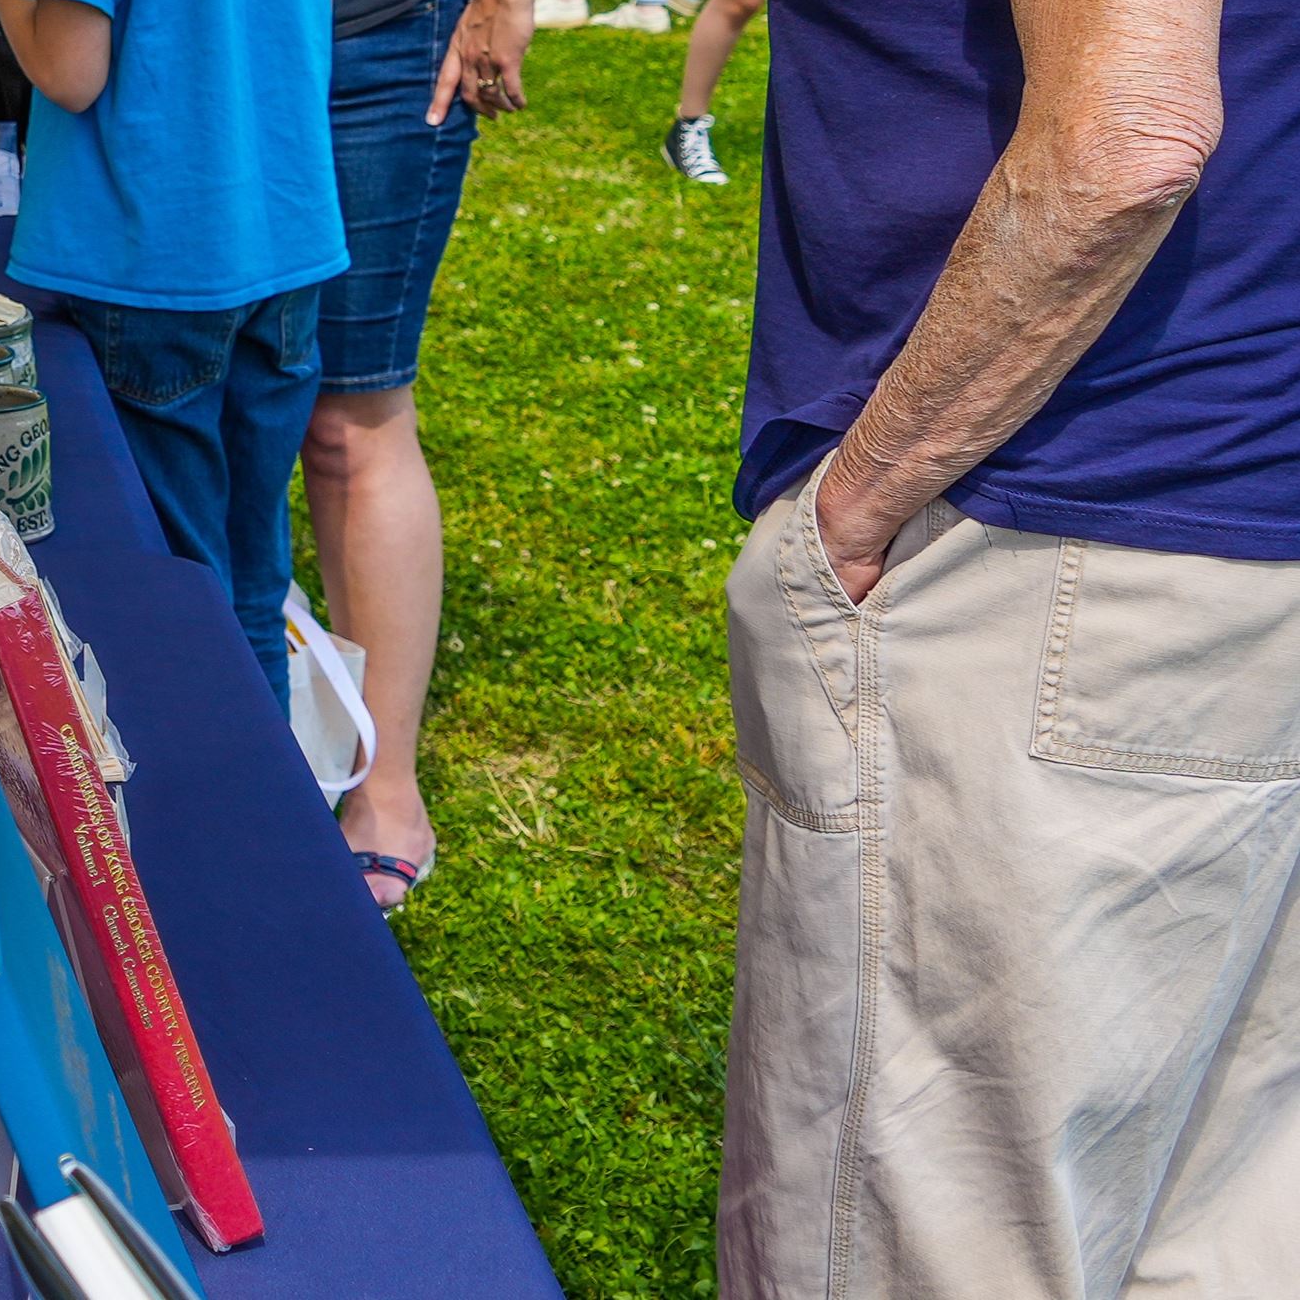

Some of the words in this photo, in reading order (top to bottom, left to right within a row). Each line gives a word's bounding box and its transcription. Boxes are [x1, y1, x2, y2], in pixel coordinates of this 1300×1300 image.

[60, 723, 104, 826] CEMETERIES
[74, 822, 100, 878] Volume
[96, 825, 116, 849] OF
[103, 849, 130, 895] KING
[121, 895, 154, 964] GEORGE
[102, 903, 130, 956] Church
[122, 956, 153, 1030] Cemeteries
[146, 963, 179, 1037] COUNTY,
[172, 1037, 205, 1112] VIRGINIA
